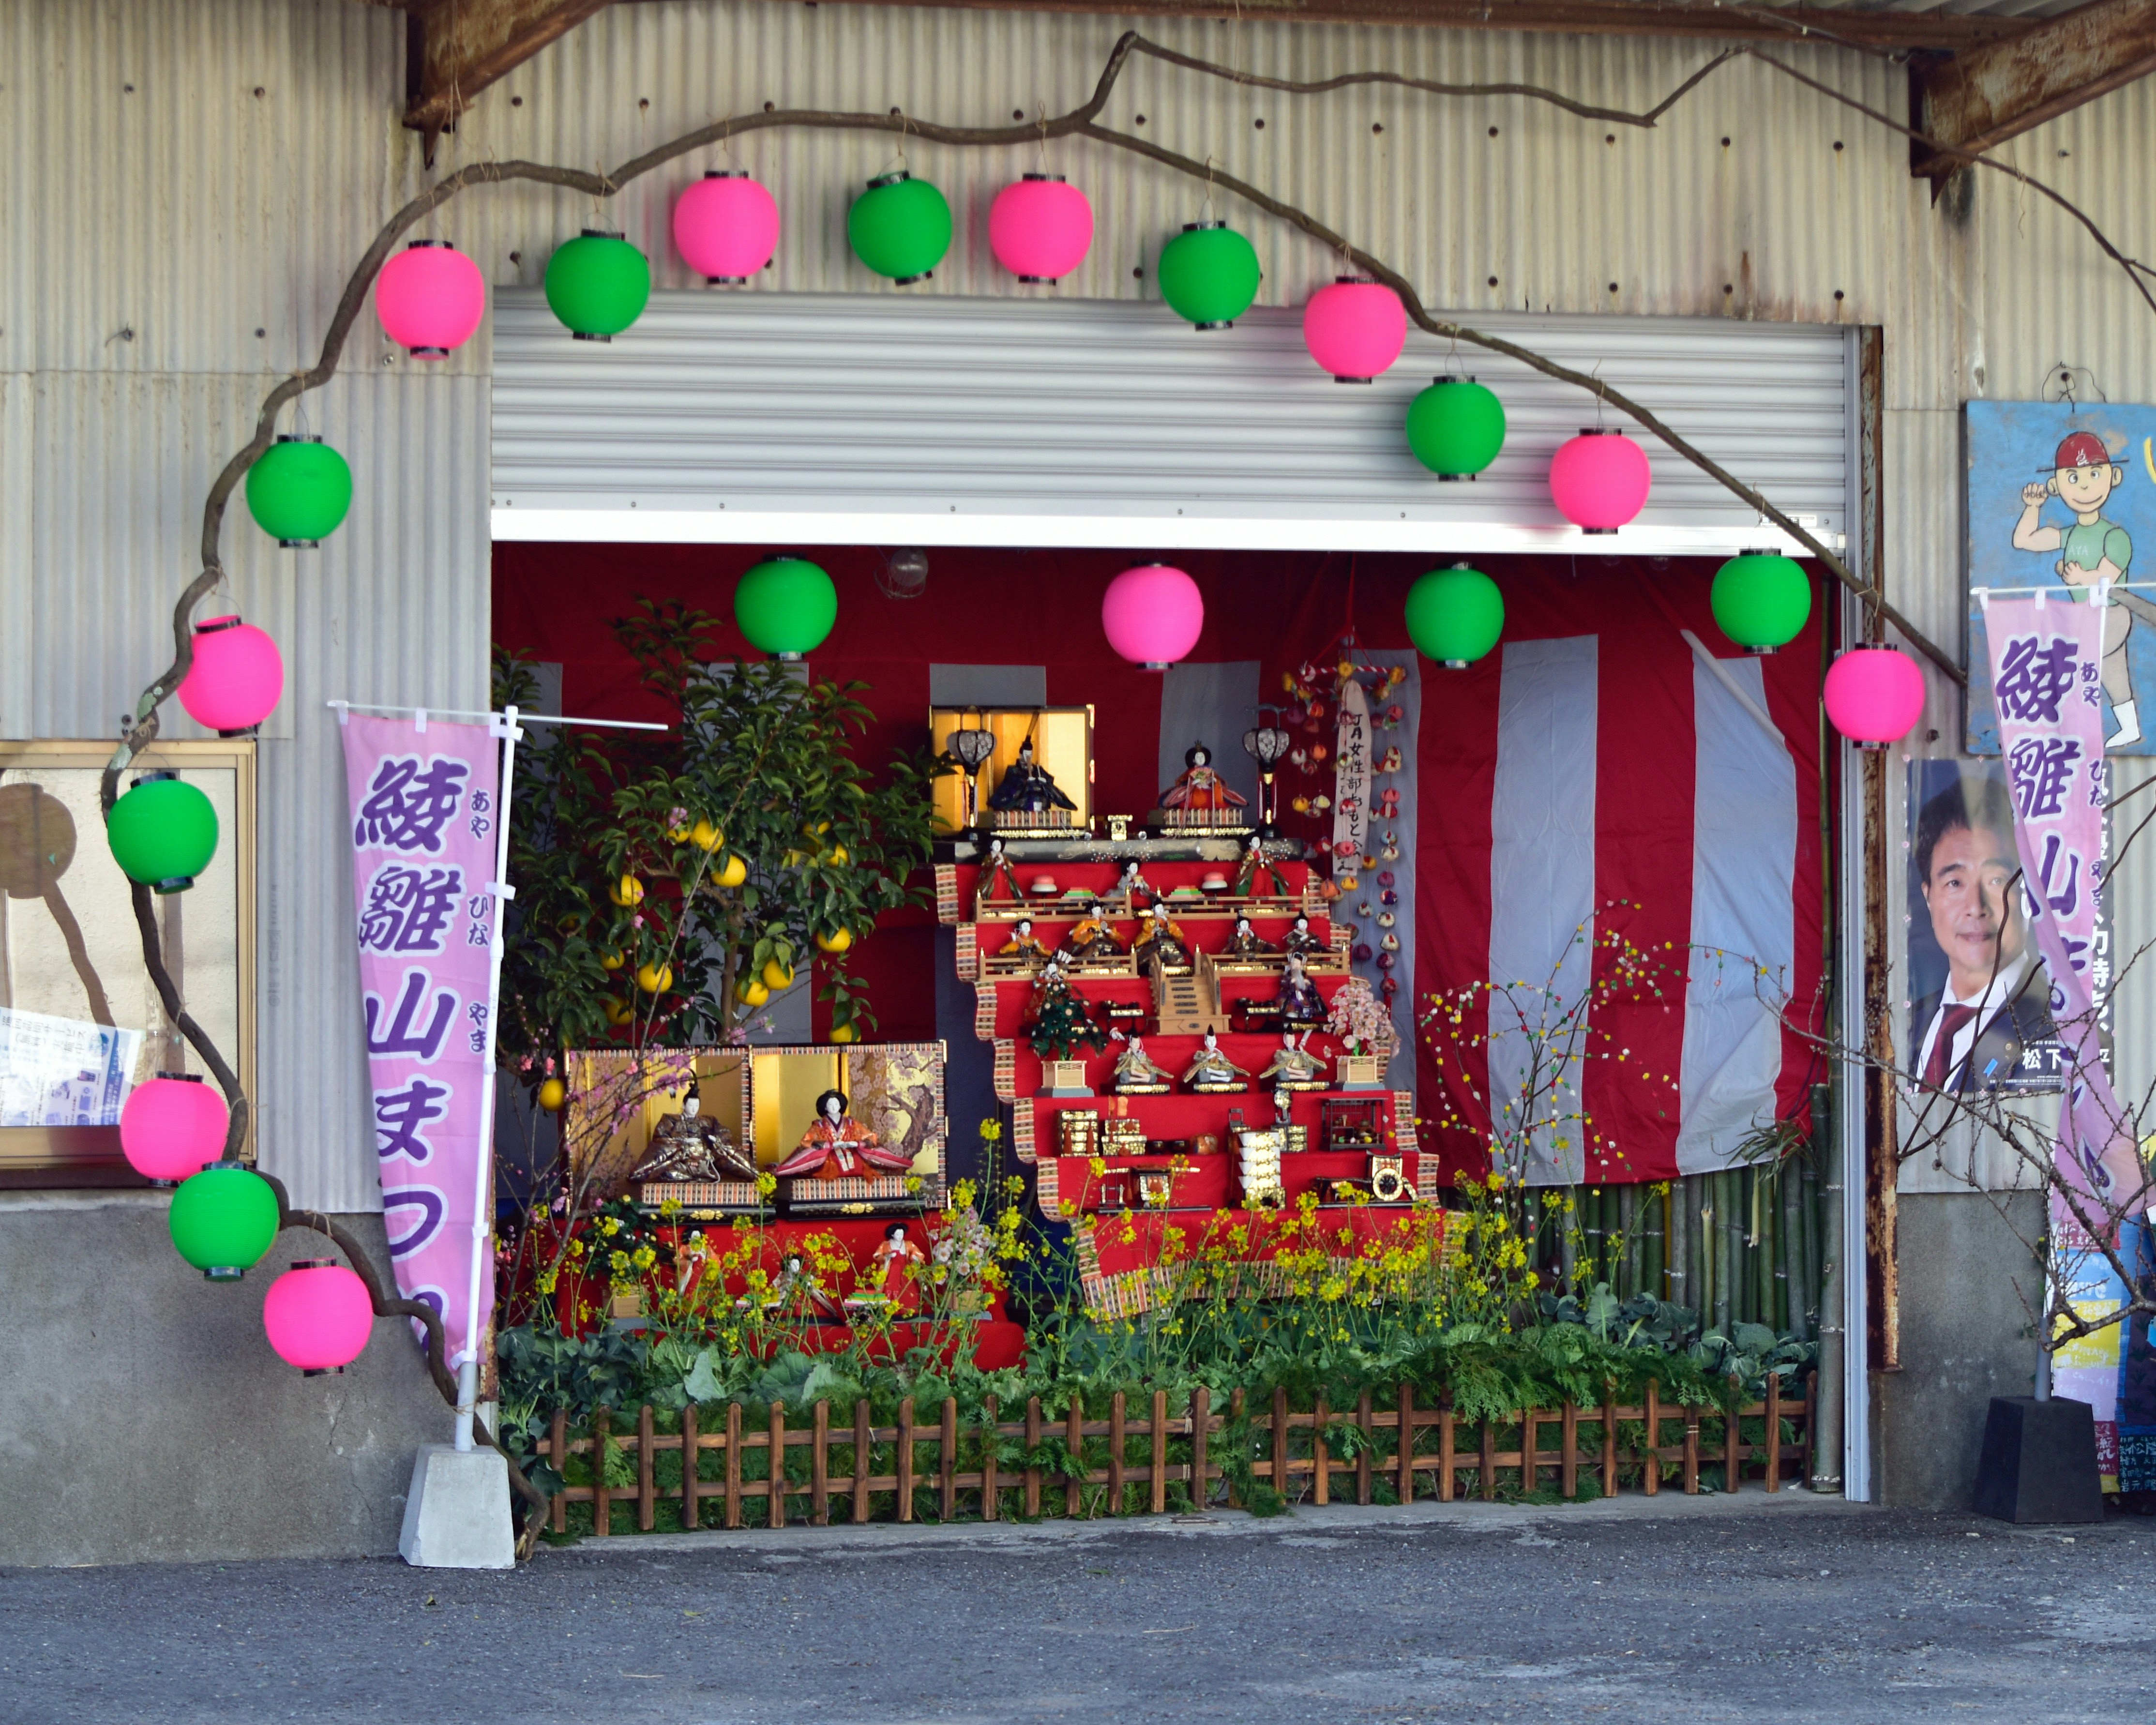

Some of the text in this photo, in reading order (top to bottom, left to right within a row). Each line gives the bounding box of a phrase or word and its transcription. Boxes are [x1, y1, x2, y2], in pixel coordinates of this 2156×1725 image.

[2067, 545, 2089, 556] AYA
[2081, 662, 2100, 708] あや
[468, 789, 490, 1052] あや ひな やま
